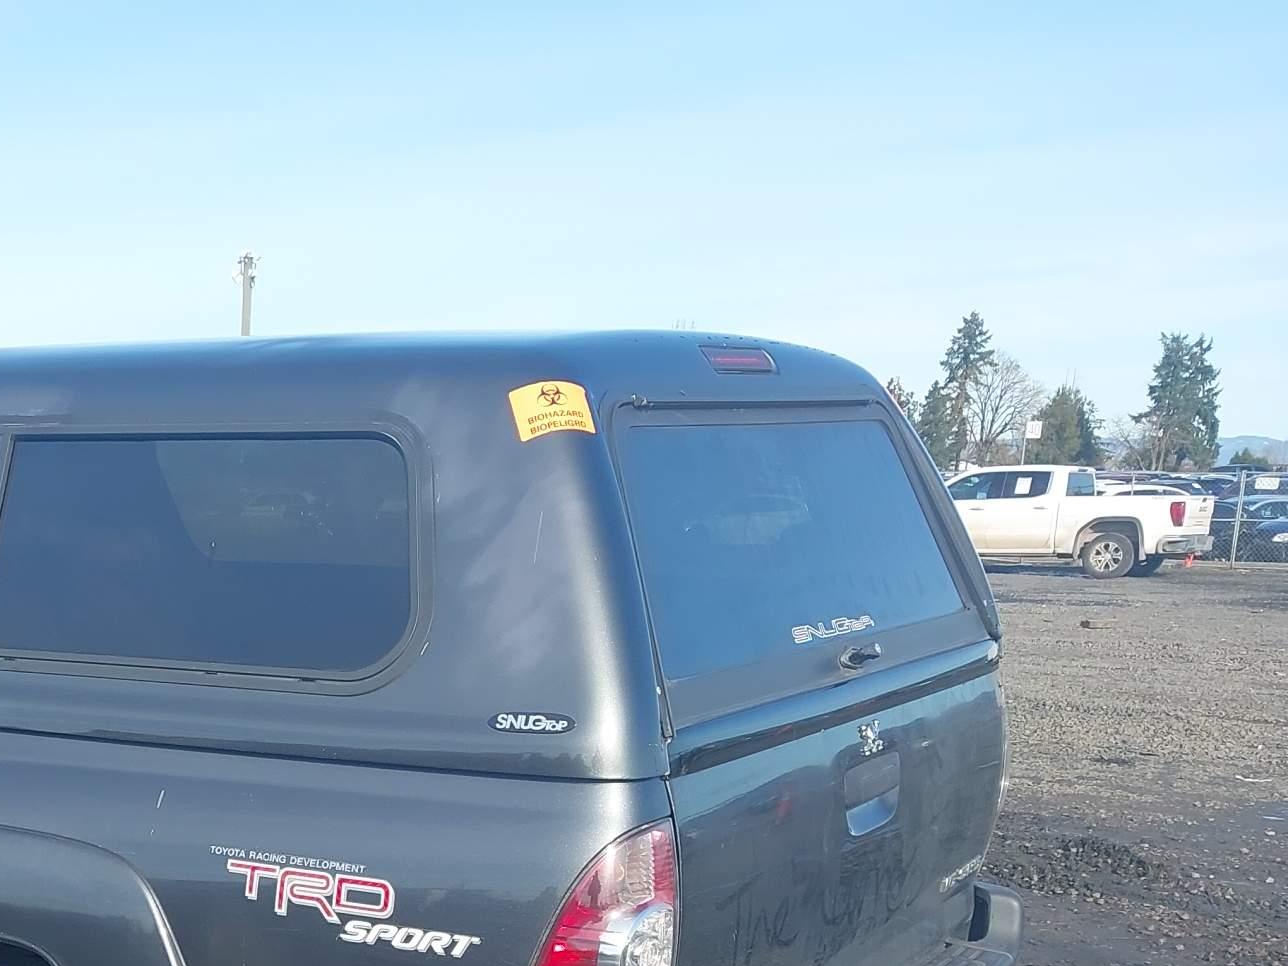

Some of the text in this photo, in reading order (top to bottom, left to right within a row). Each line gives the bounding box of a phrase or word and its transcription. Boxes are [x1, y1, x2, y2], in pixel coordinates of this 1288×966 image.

[528, 409, 584, 425] BIOHAZARD
[530, 419, 587, 435] BIOPELIGRO
[209, 845, 367, 875] TOYOTA RACING DEVELOPMENT
[226, 858, 395, 925] TRD
[337, 919, 483, 959] SPORT
